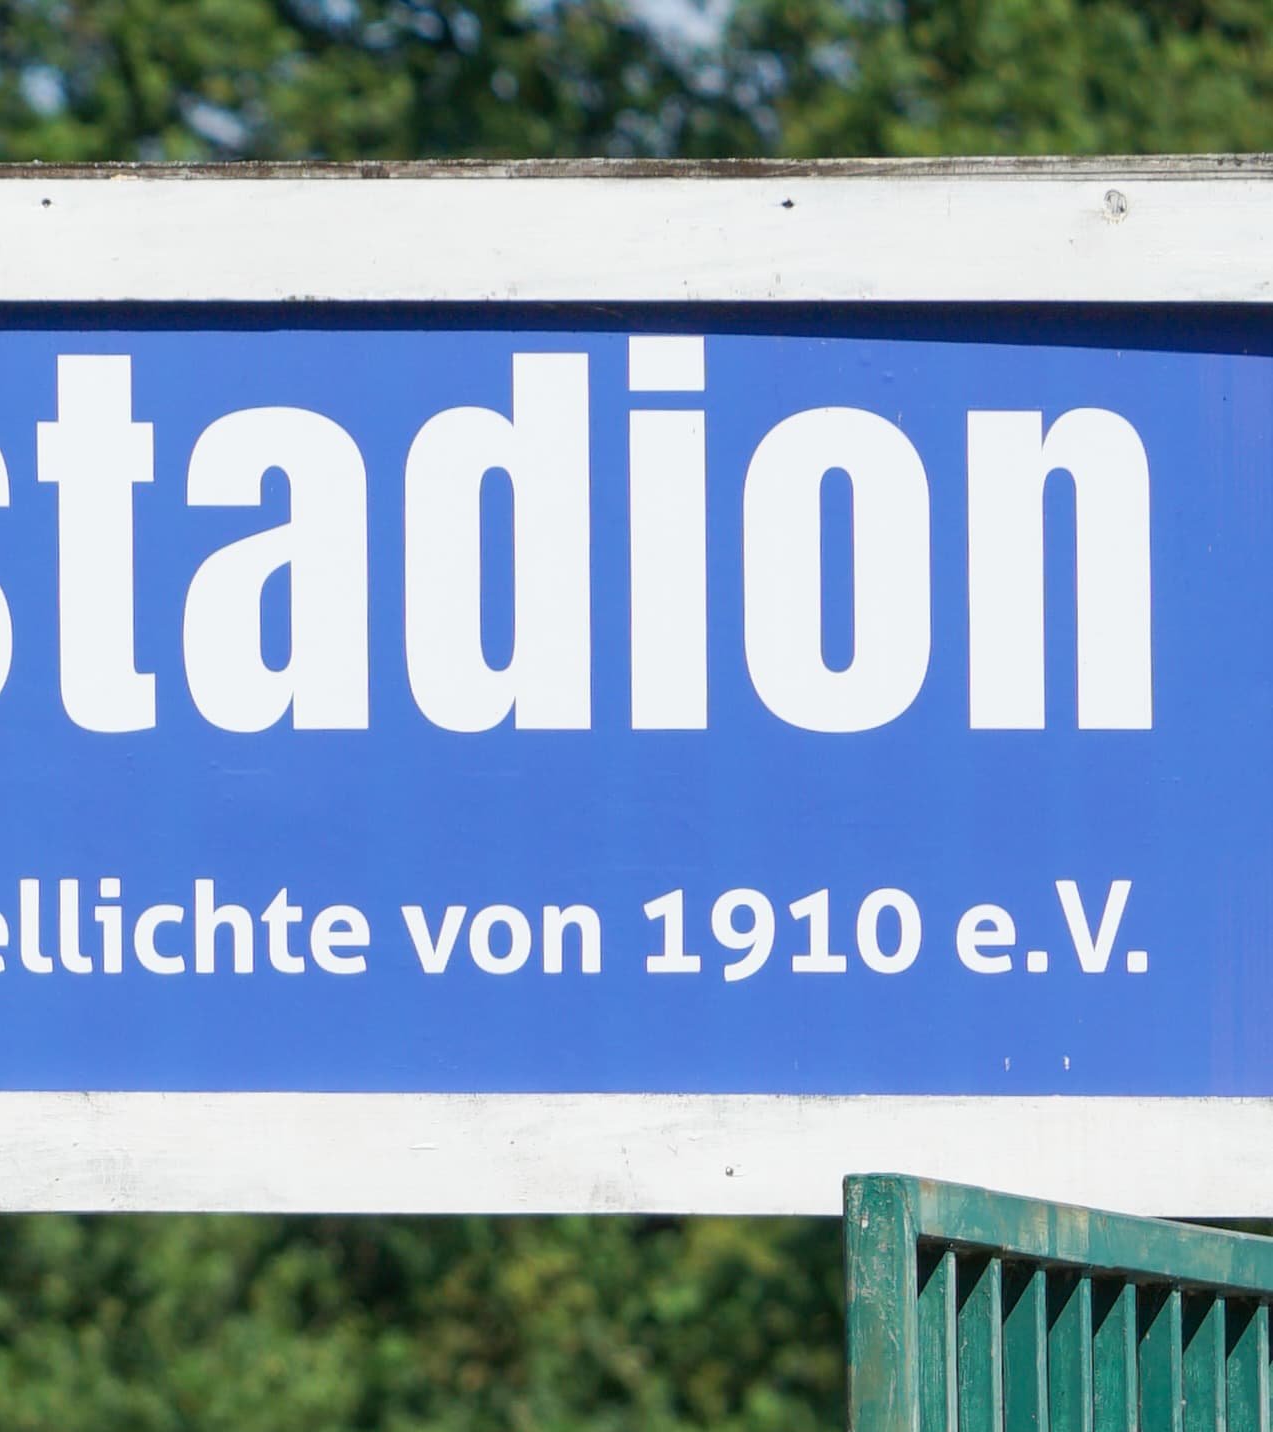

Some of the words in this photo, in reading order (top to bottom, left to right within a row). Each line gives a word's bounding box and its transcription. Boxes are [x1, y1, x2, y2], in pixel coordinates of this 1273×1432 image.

[400, 904, 602, 974] von
[643, 887, 922, 982] 1910
[955, 879, 1148, 974] e.V.
